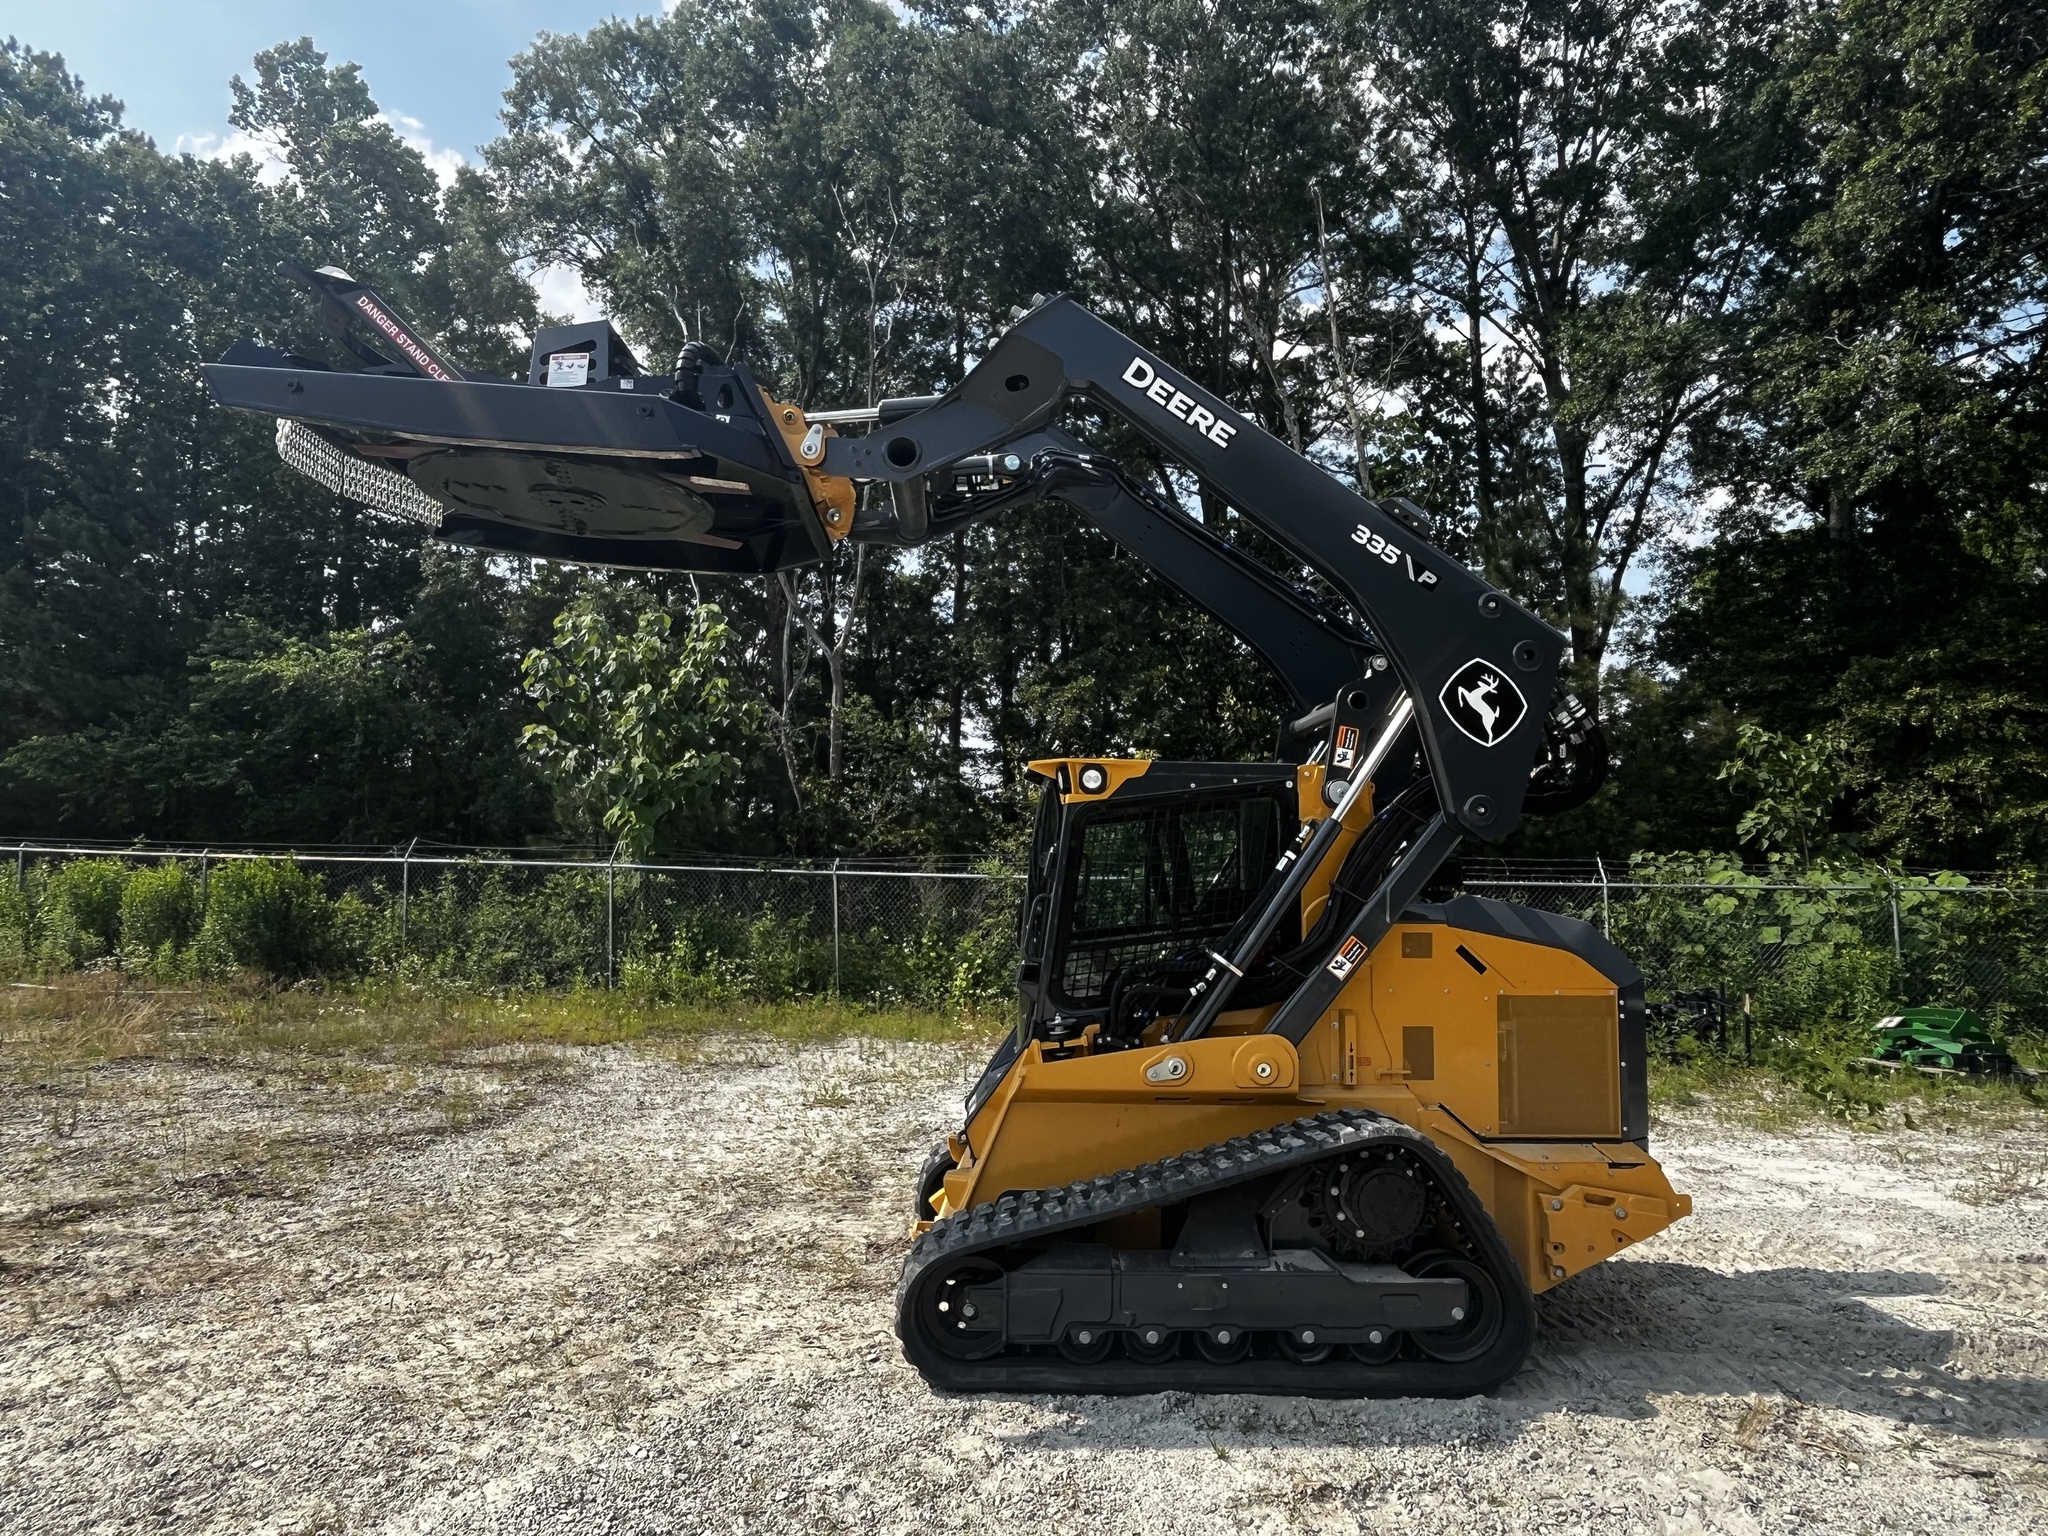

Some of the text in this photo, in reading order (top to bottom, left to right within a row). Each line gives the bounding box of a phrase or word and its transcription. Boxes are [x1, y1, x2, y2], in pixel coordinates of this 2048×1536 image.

[357, 296, 399, 337] DANGER
[396, 333, 430, 366] STAND
[1122, 356, 1237, 449] DEERE
[1351, 524, 1402, 565] 335
